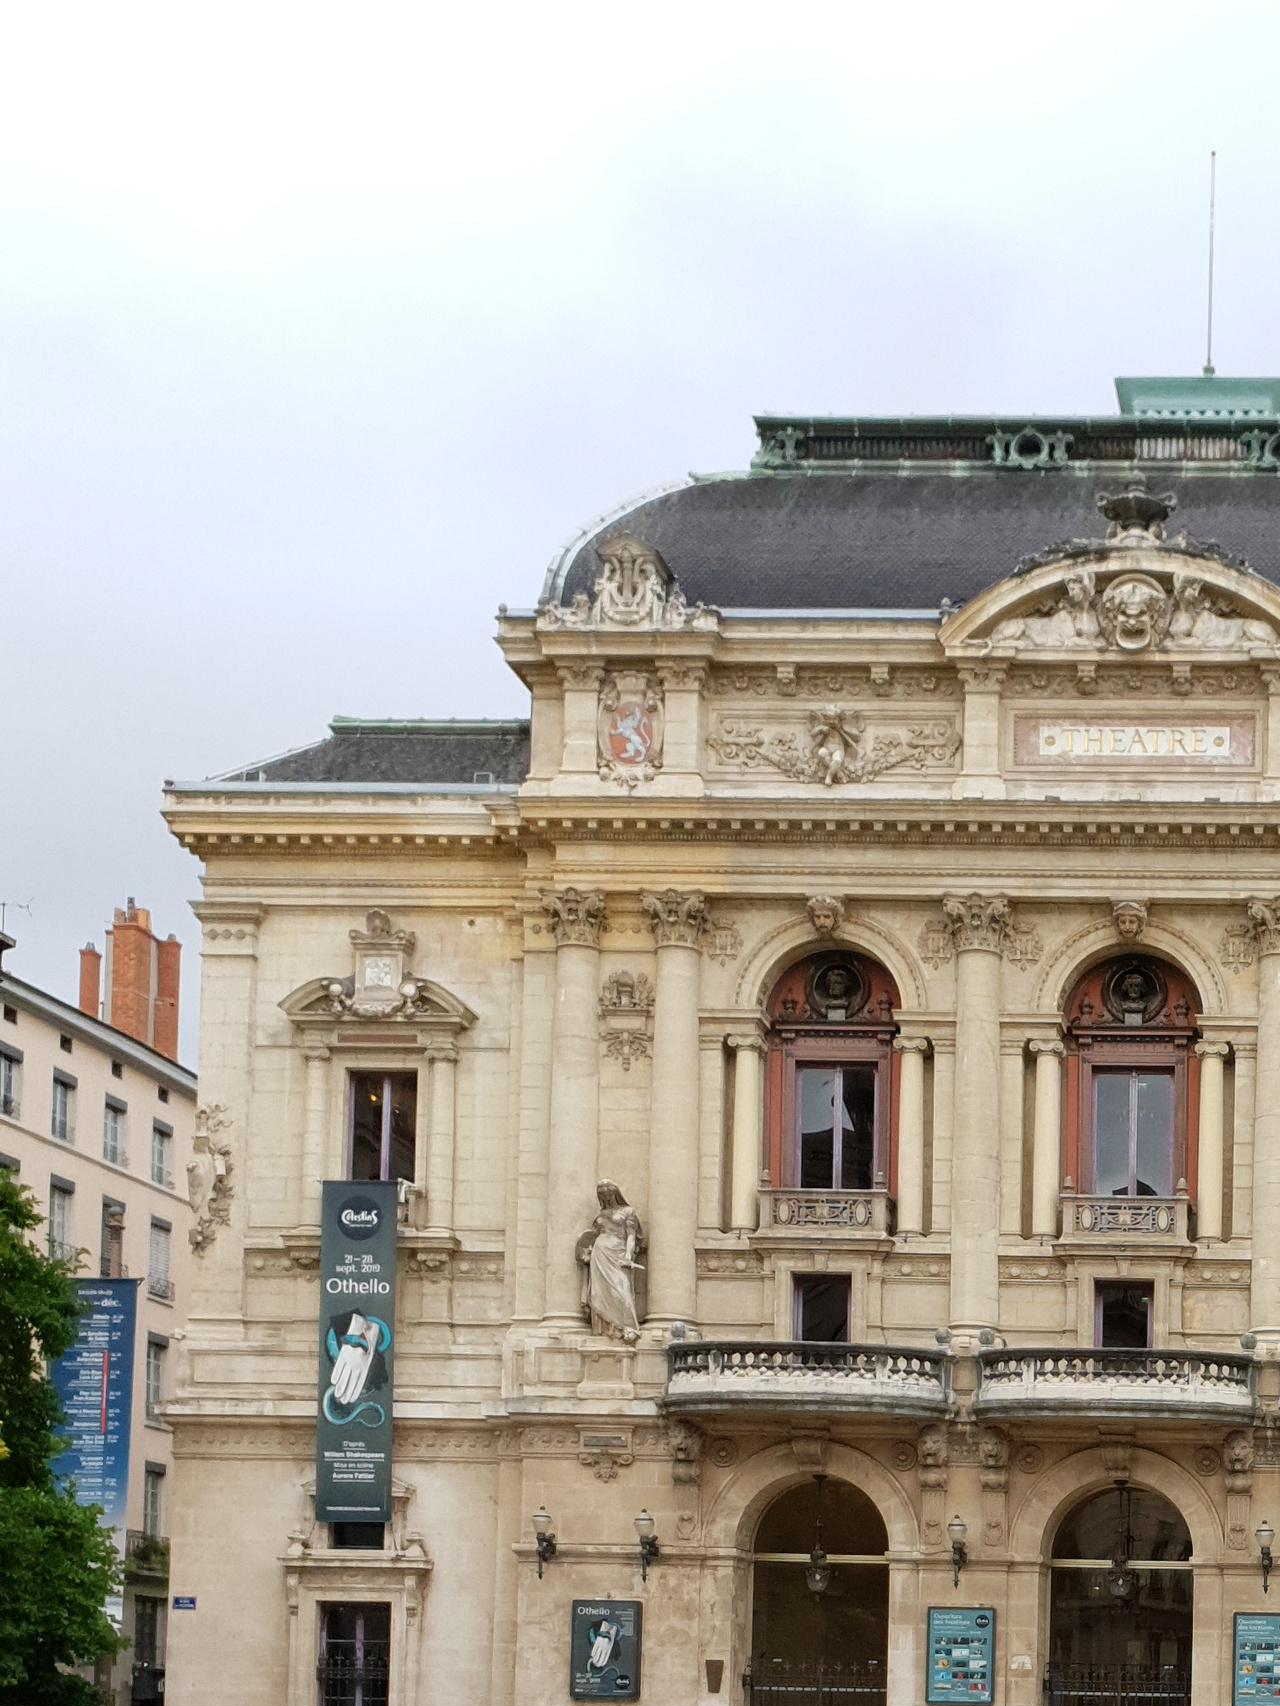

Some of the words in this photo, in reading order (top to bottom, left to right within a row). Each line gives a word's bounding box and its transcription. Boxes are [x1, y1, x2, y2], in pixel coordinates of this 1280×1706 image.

[1061, 729, 1208, 754] THEATRE
[336, 1264, 358, 1275] sept.
[361, 1264, 380, 1273] 2019
[326, 1277, 390, 1294] Othello
[577, 1606, 610, 1616] Othello
